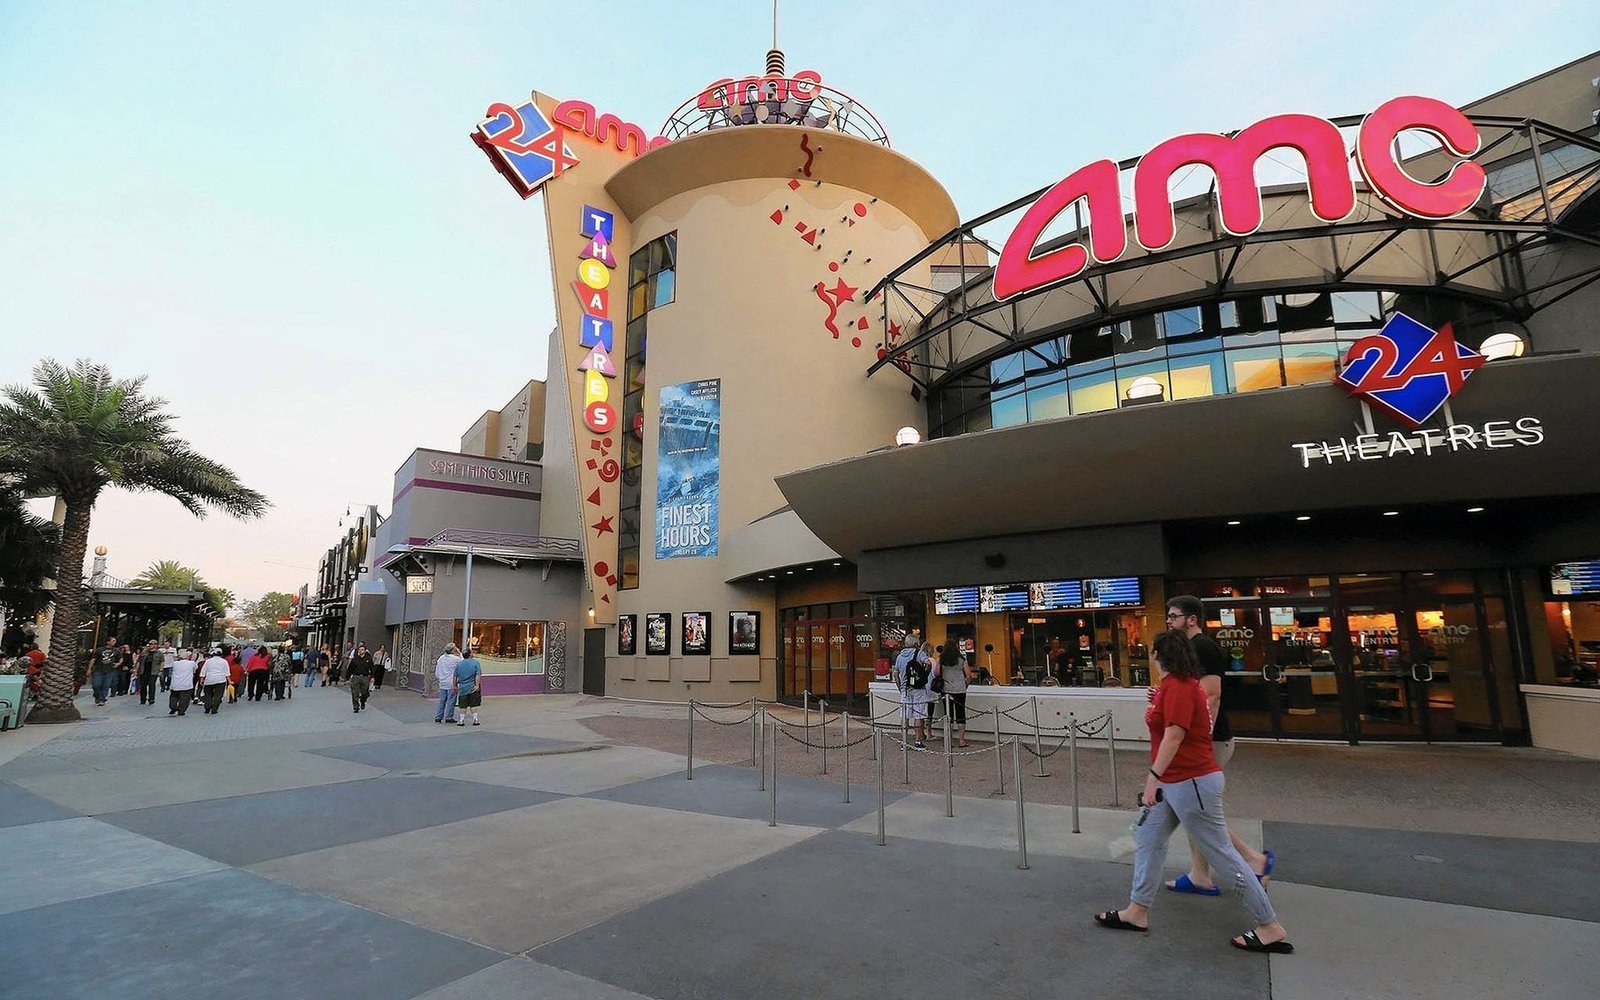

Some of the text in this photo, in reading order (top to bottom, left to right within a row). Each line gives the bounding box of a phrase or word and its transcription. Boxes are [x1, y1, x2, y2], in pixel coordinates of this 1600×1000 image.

[697, 69, 822, 111] amc
[485, 102, 581, 179] 24
[992, 95, 1488, 302] amc
[589, 213, 609, 425] THEATRES
[1342, 320, 1488, 398] 24
[1292, 417, 1545, 468] THEATRES
[429, 460, 530, 485] SOMETHING SILVER
[661, 503, 712, 527] FINEST
[661, 524, 711, 548] HOURS
[1216, 628, 1254, 639] amc
[1221, 639, 1250, 648] ENTRY
